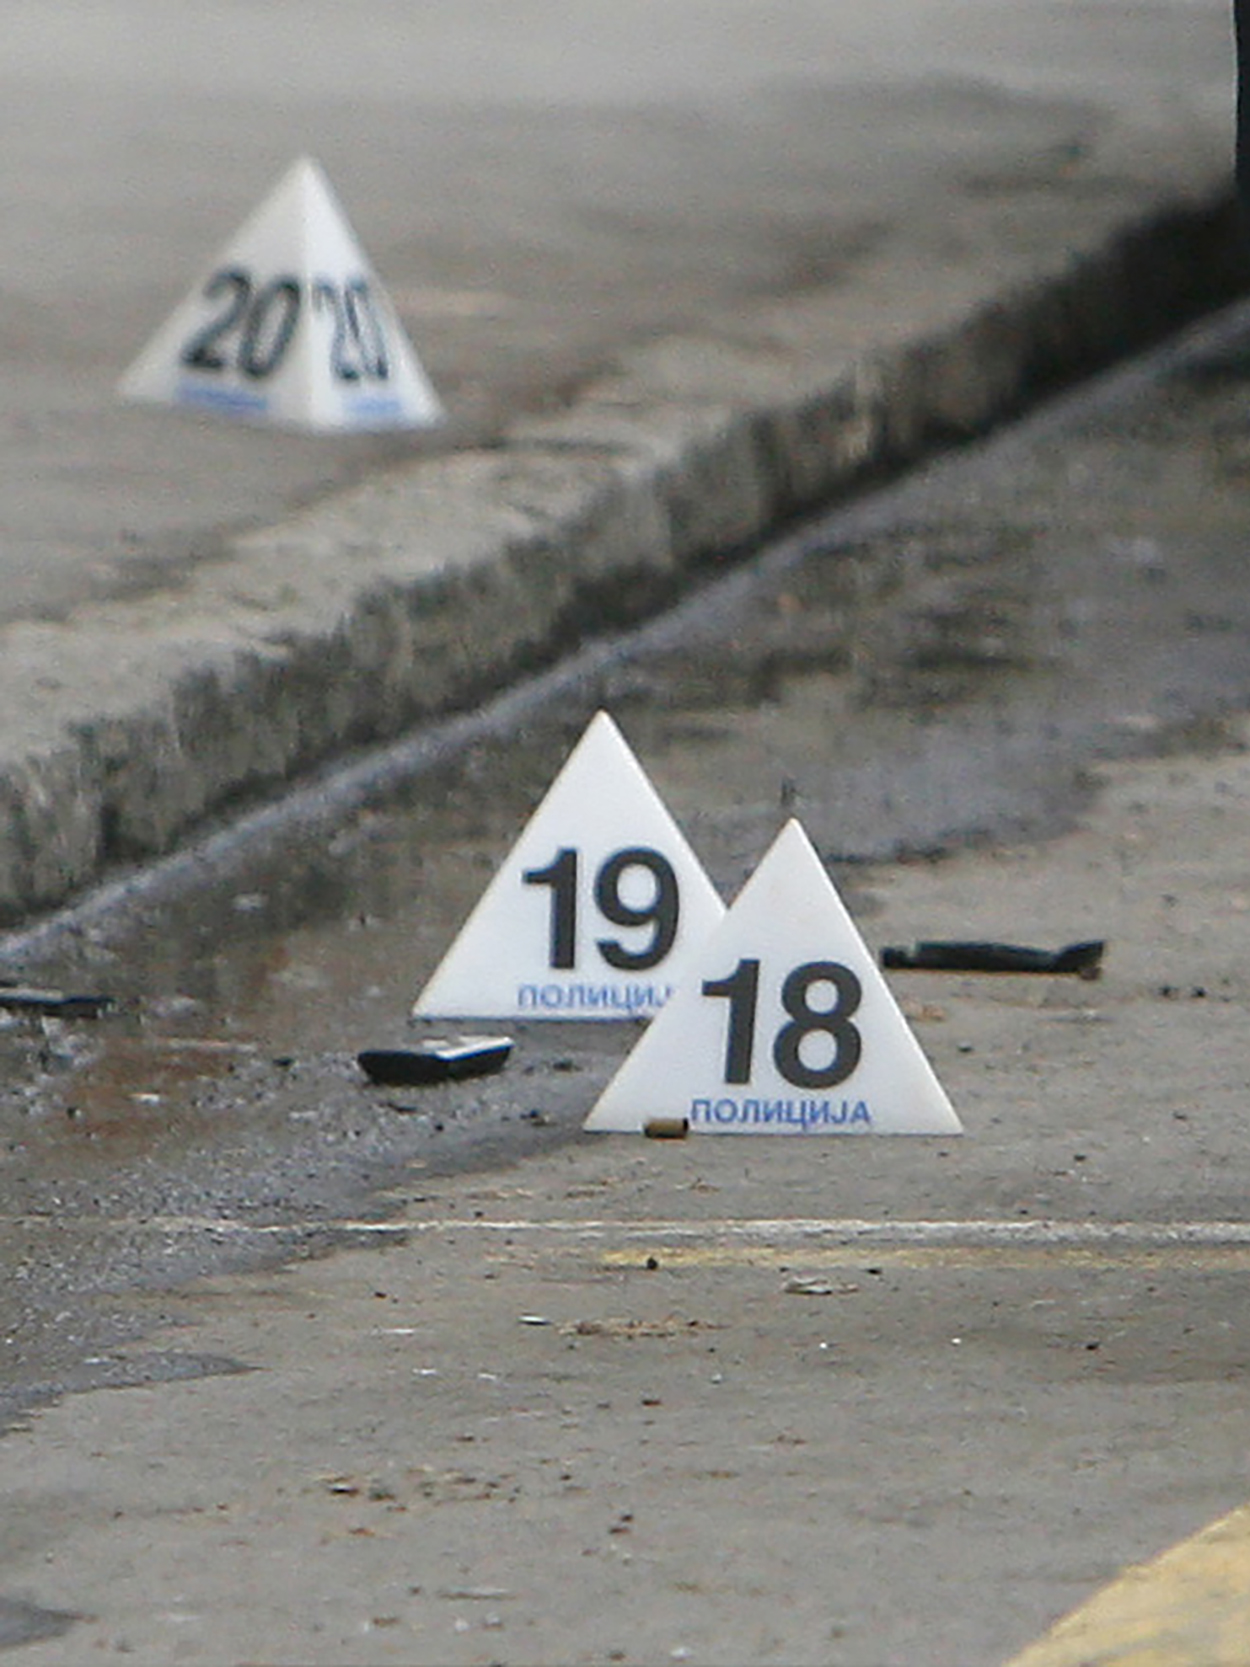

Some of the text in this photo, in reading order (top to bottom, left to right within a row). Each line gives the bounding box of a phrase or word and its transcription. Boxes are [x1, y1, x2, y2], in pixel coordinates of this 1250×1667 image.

[180, 265, 300, 379] 20
[522, 846, 681, 972] 19
[517, 983, 674, 1014] ПОЛИЦИЈ
[701, 957, 863, 1090] 18
[690, 1098, 872, 1131] ПОЛИЦИЈА
